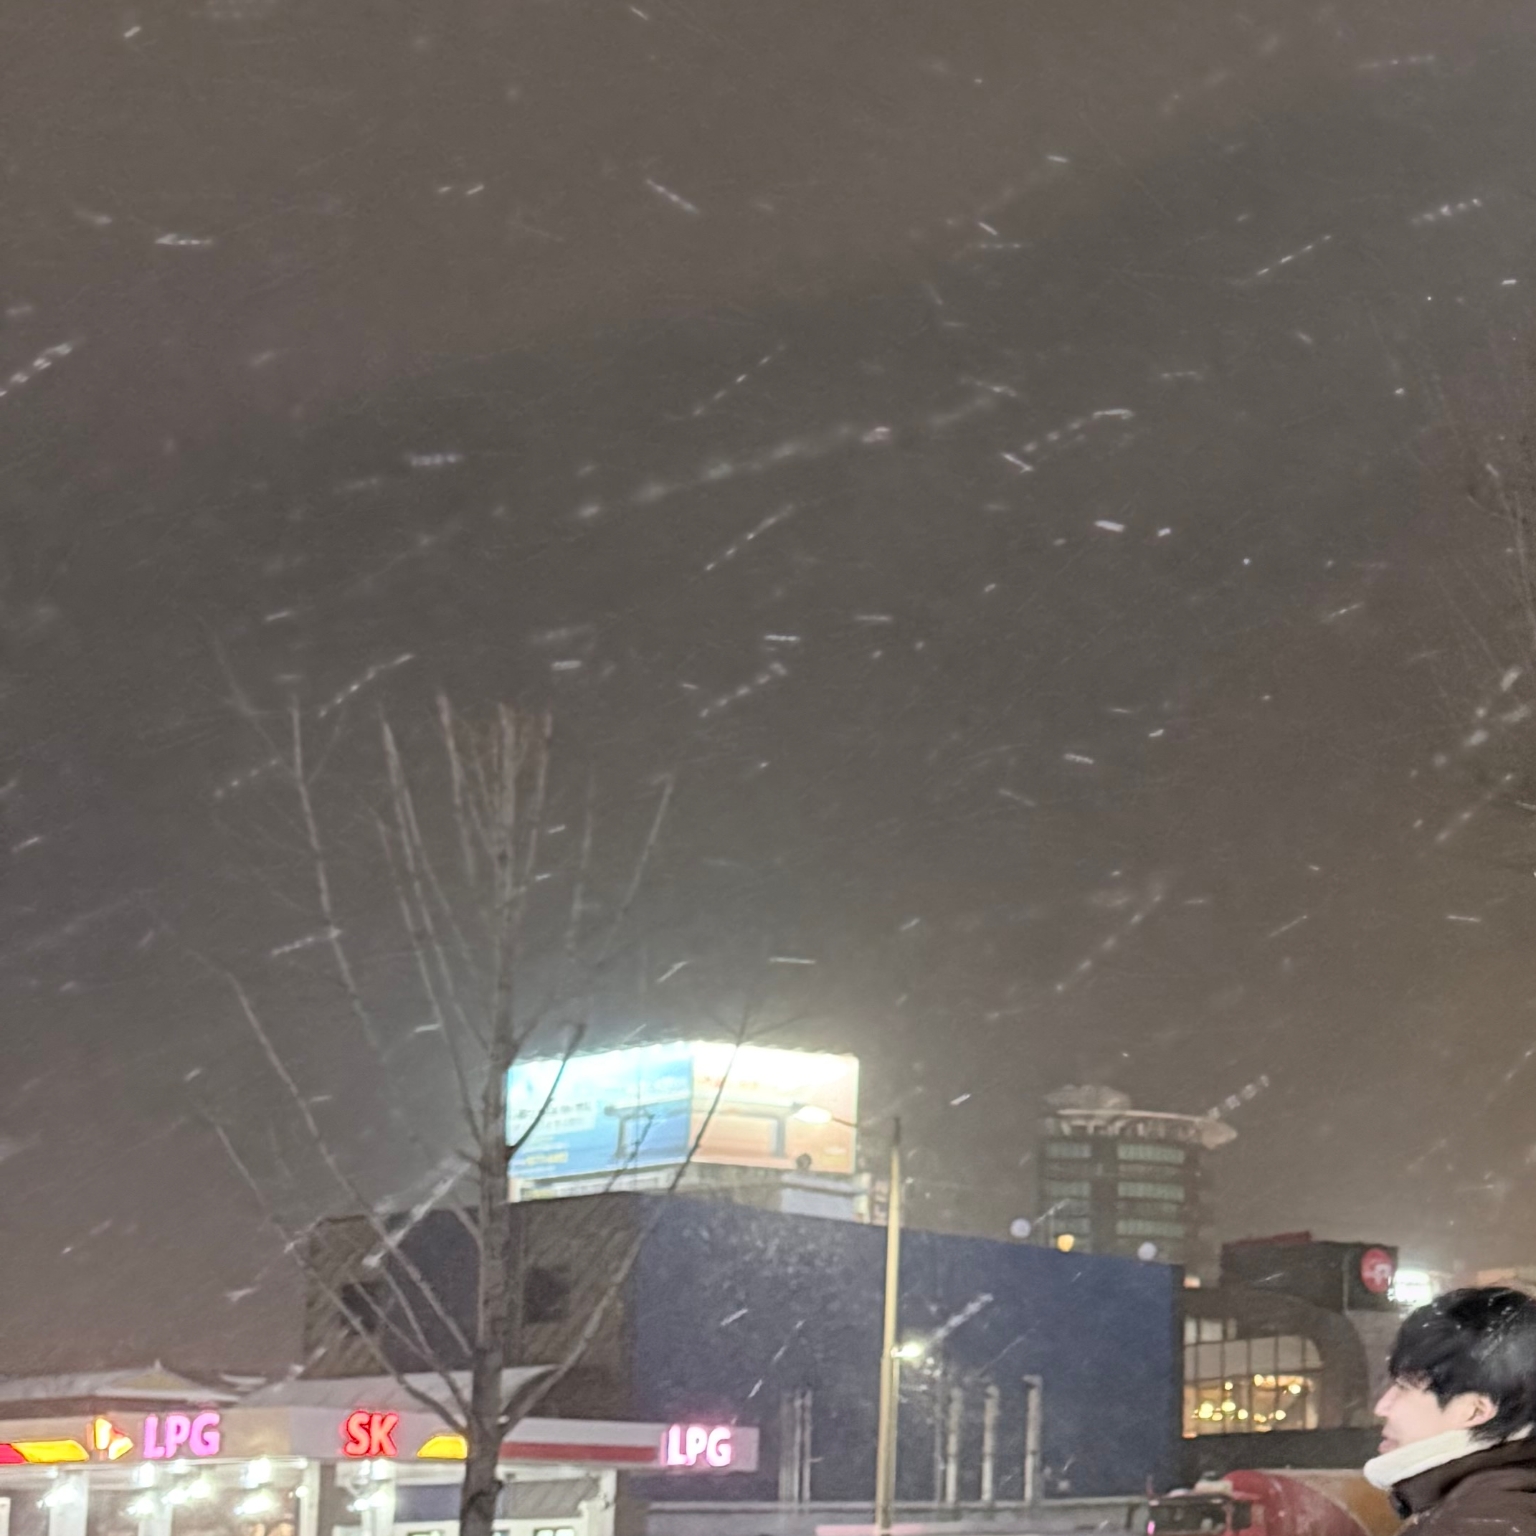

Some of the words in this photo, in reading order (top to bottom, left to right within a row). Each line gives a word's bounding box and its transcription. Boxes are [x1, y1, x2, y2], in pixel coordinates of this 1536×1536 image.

[143, 1411, 221, 1459] LPG
[344, 1410, 399, 1457] SK
[667, 1424, 732, 1467] LPG
